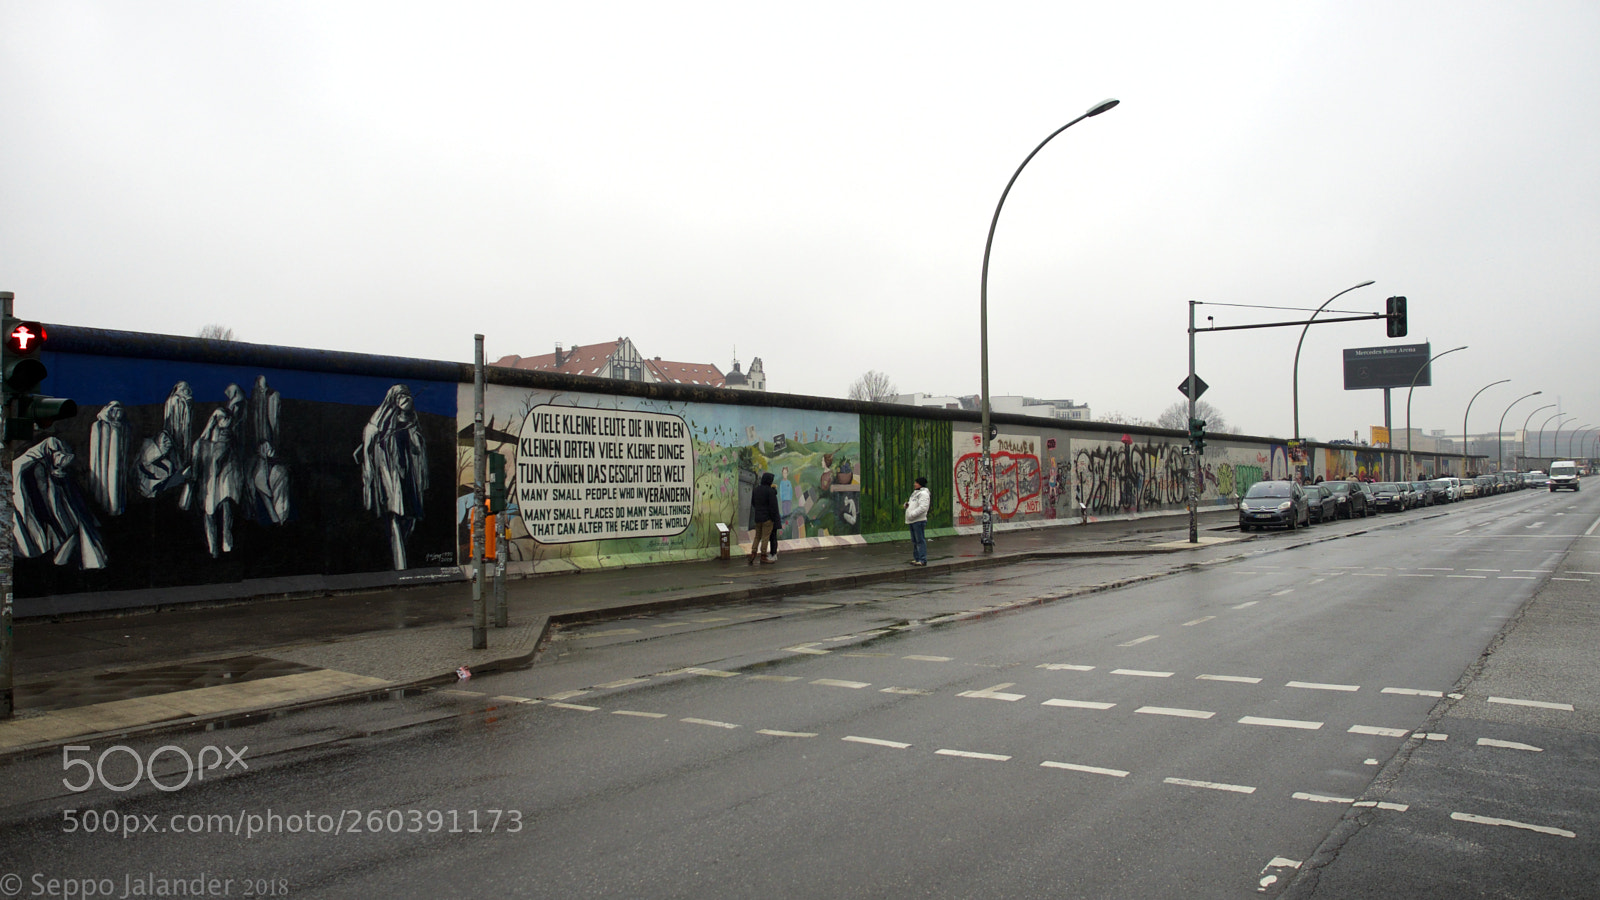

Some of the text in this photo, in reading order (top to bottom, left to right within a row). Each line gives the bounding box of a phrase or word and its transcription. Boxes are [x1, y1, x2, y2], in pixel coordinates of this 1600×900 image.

[532, 412, 684, 438] VIELE KLEINE LEUTE DIE IN VIELEN
[521, 438, 685, 460] KLEINEN ORTEN VIELE KLEINE DINGE
[588, 465, 606, 483] DAS
[609, 465, 644, 483] GESICHT
[646, 465, 662, 483] DER
[663, 465, 685, 482] WELT
[521, 485, 691, 502] MANY SMALL PEOPLE WHO IN VERÄNDERN
[525, 505, 690, 521] MANY SMALL PLACES DO MANY SMALL THINGS
[532, 518, 687, 536] THAT CAN ALTER THE FACE OF THE WORLD
